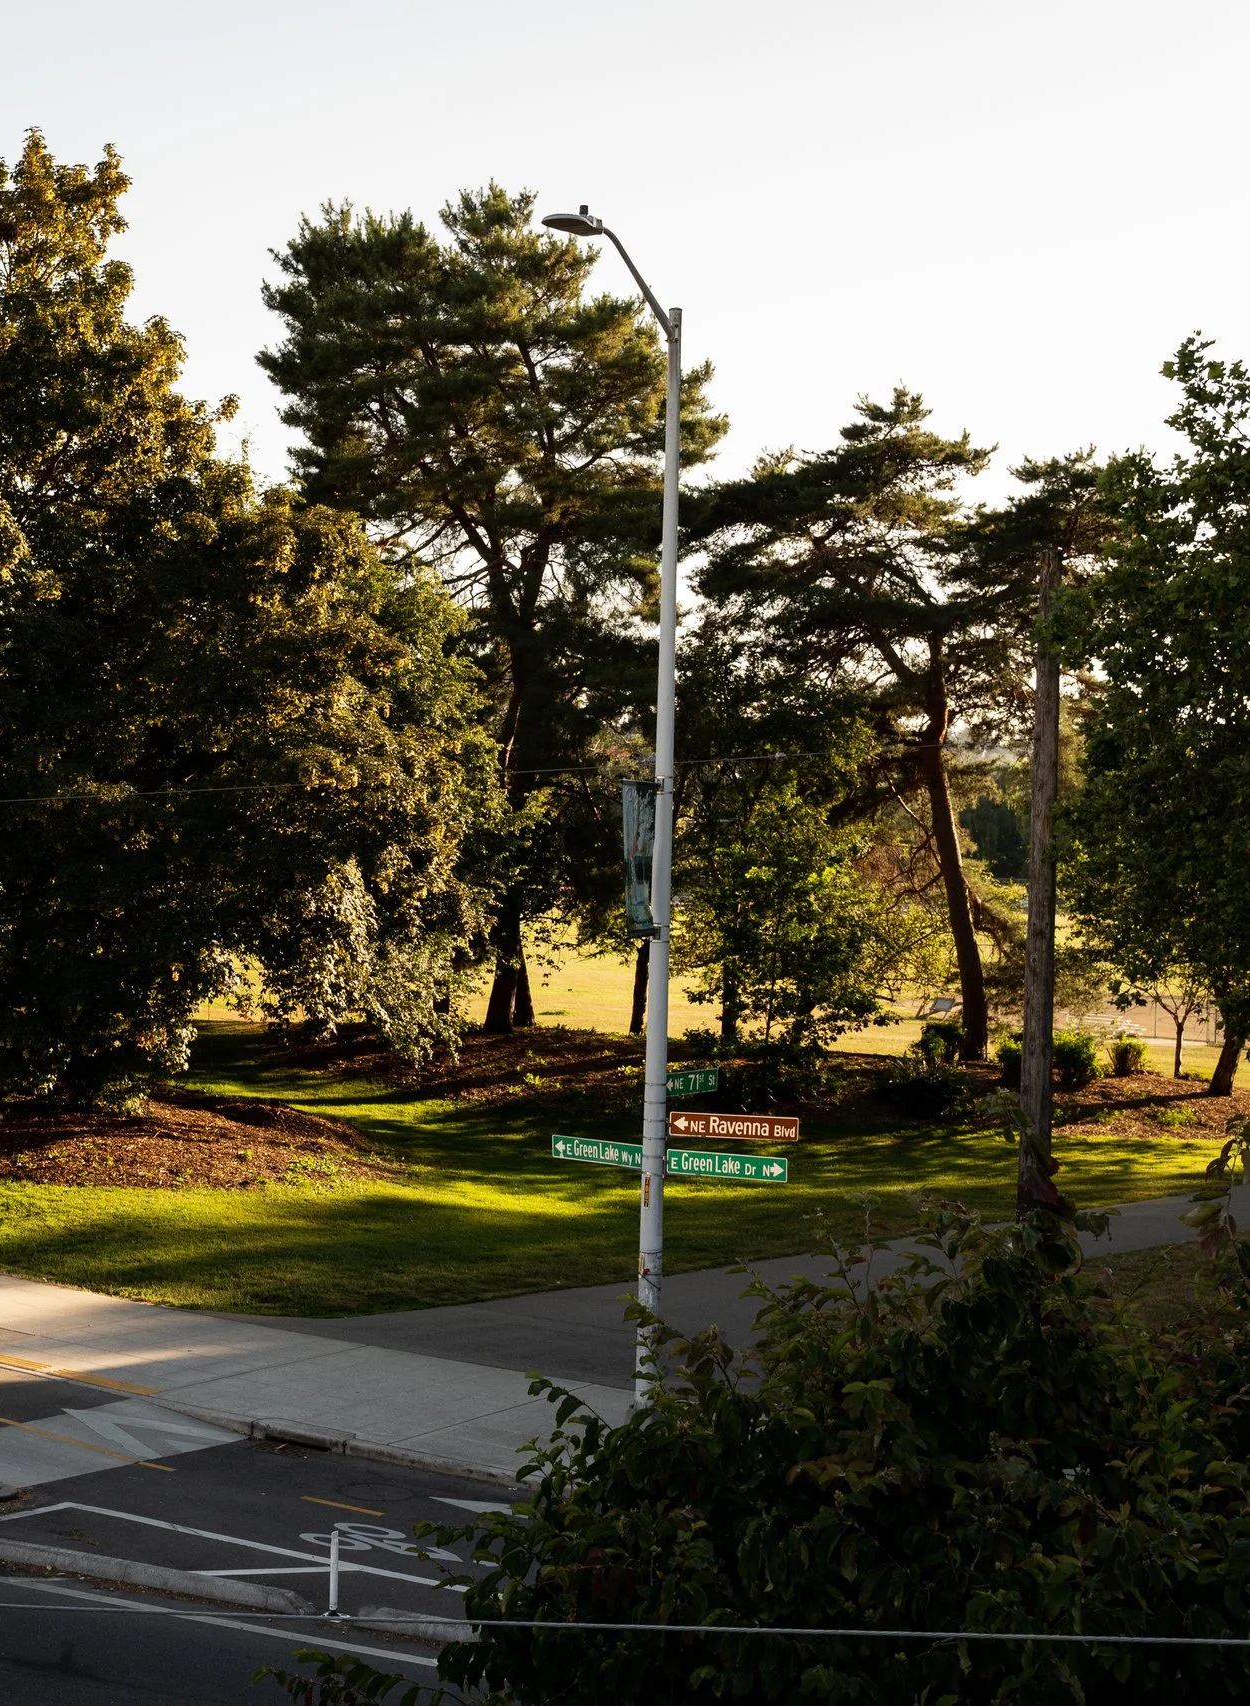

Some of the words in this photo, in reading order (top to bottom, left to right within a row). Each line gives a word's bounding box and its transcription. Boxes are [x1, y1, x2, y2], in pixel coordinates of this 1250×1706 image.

[674, 1077, 684, 1090] NE
[688, 1073, 705, 1091] 71st
[708, 1076, 715, 1086] St
[690, 1120, 706, 1133] NE
[709, 1116, 769, 1136] Ravenna
[773, 1125, 796, 1138] Blvd
[566, 1143, 572, 1155] E
[573, 1139, 598, 1158] Green
[599, 1142, 619, 1161] Lake
[621, 1150, 633, 1165] Wy
[635, 1152, 641, 1165] N
[671, 1157, 678, 1169] E
[681, 1153, 713, 1172] Green
[715, 1155, 740, 1174] Lake
[744, 1164, 756, 1176] Dr
[762, 1165, 770, 1177] N
